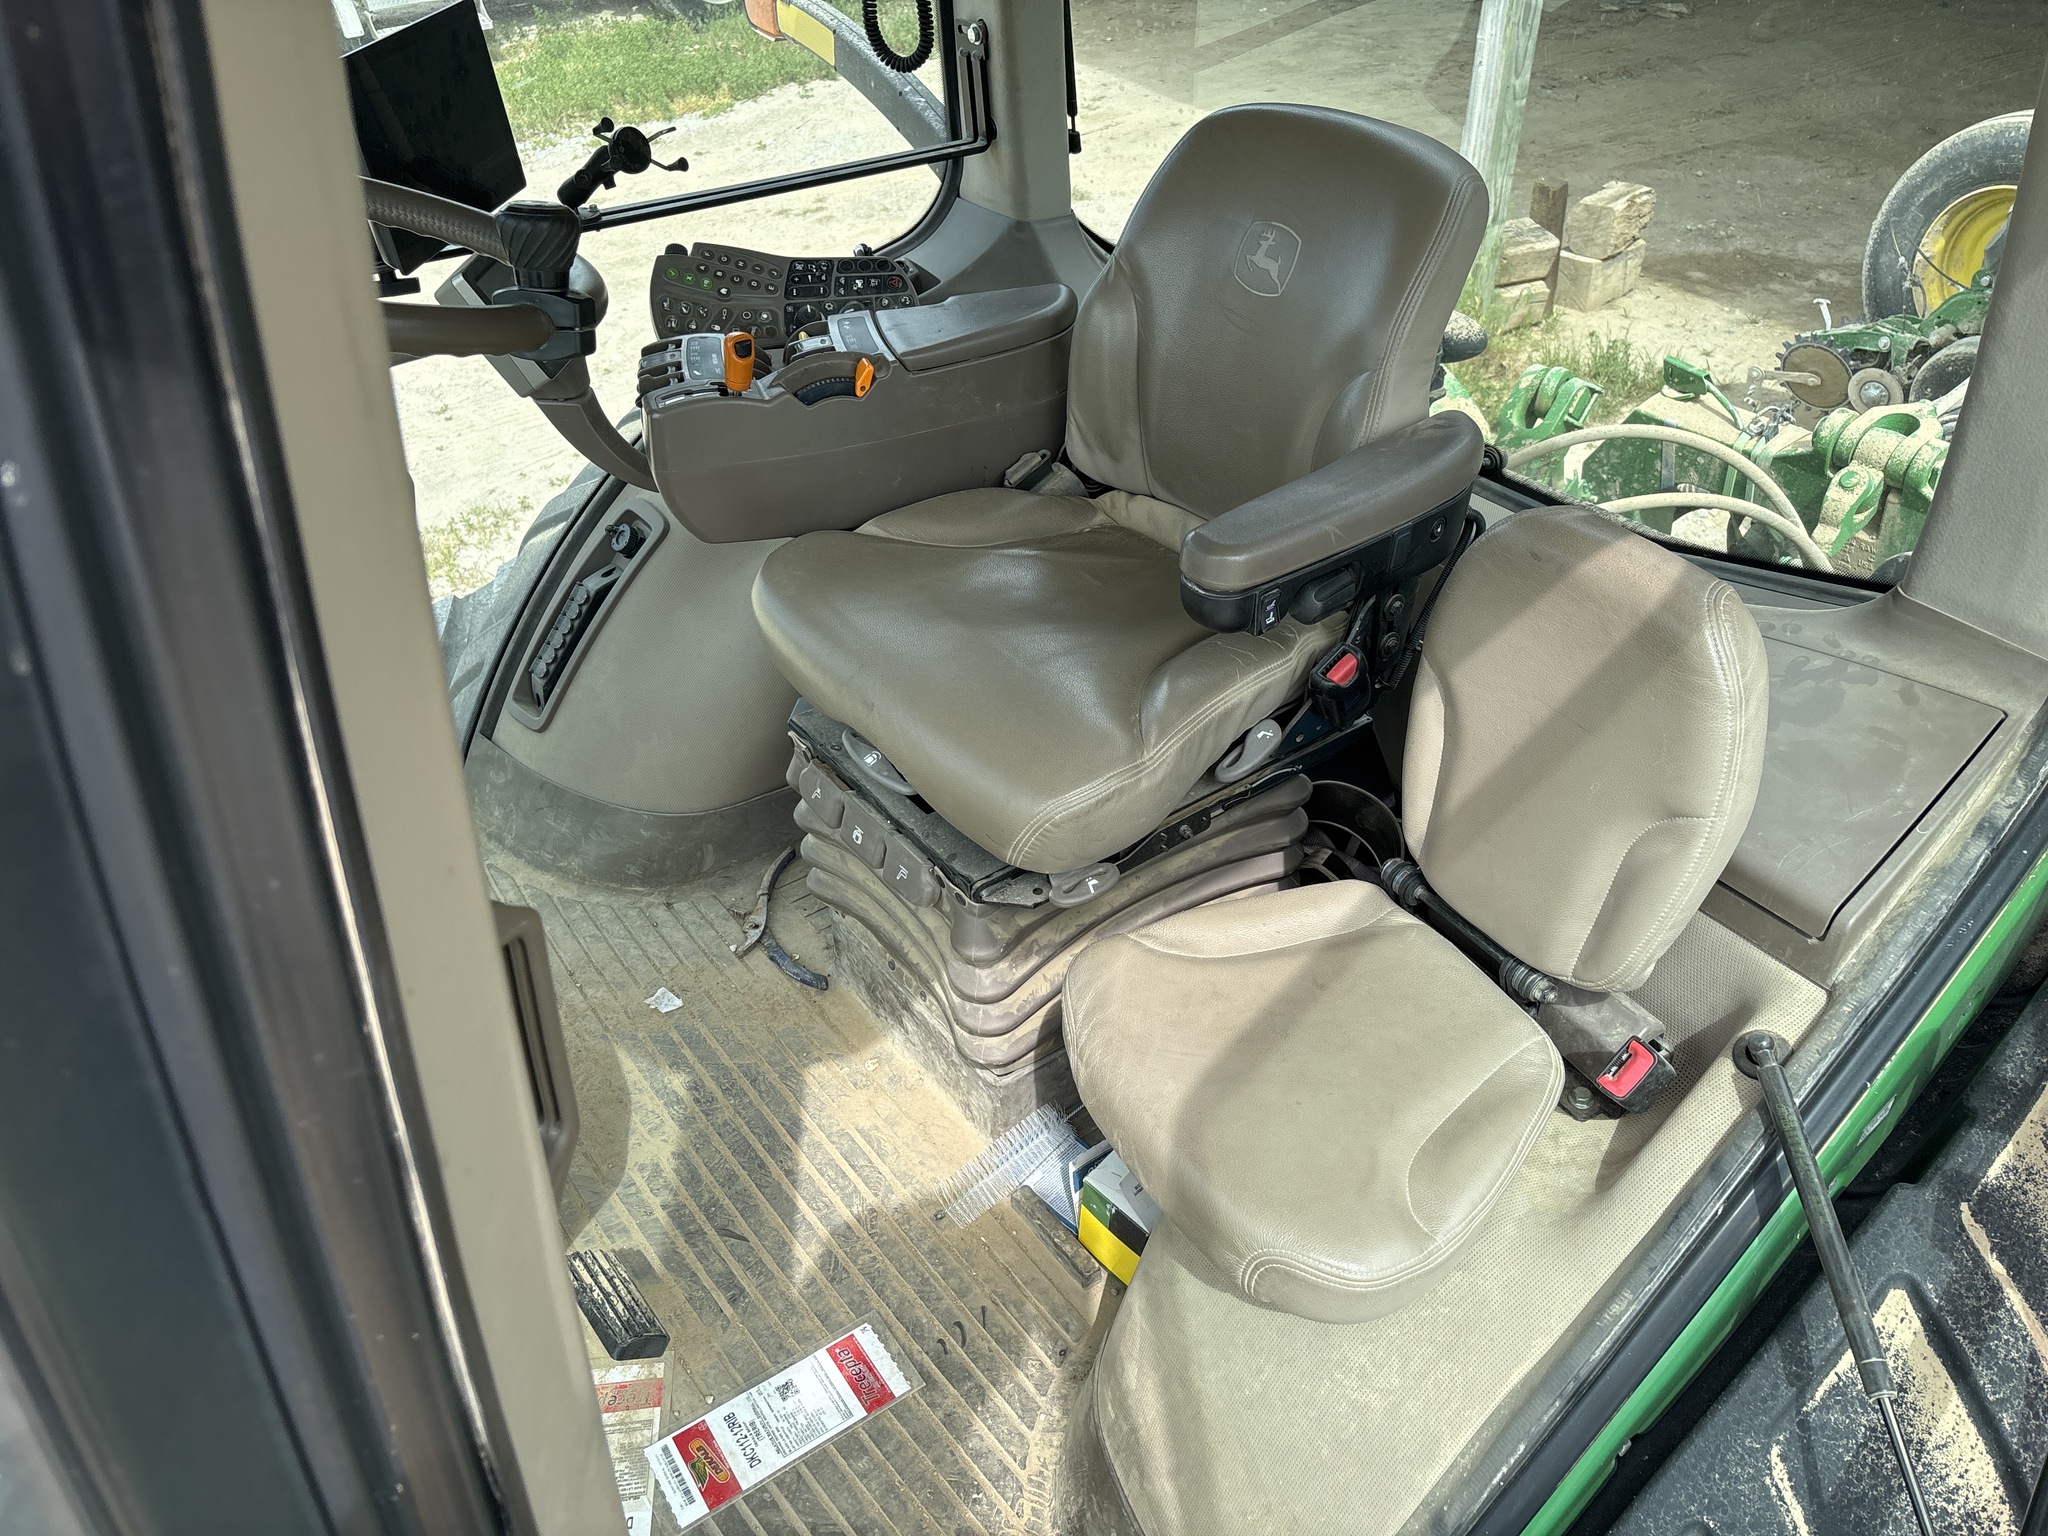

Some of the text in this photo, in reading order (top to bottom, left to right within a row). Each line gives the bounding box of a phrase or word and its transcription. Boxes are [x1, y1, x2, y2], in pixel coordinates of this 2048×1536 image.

[1857, 559, 1872, 570] USA
[833, 1344, 879, 1405] Trecepta
[695, 1444, 723, 1475] DEKALB
[722, 1411, 762, 1468] DKC112-12RIB
